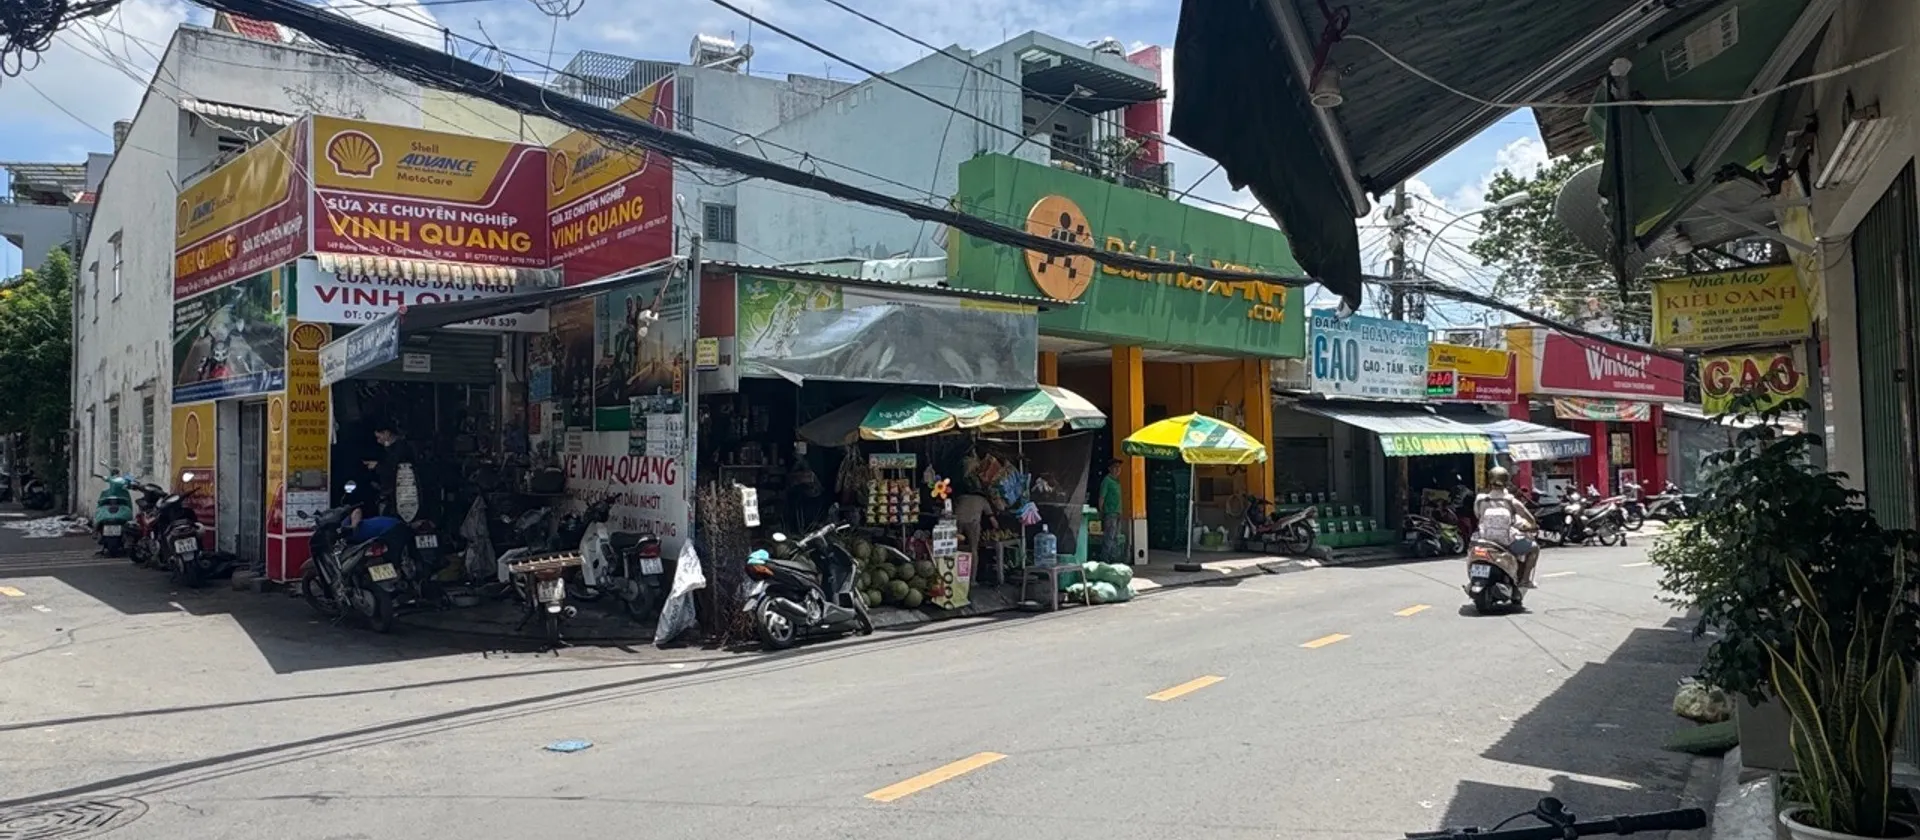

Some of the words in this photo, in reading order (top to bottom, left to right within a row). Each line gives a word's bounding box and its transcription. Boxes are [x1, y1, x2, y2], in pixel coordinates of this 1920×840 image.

[411, 141, 439, 153] Shell
[398, 153, 478, 172] ADVANCE
[397, 172, 453, 186] MotoCare
[327, 195, 361, 212] SỬA
[367, 201, 387, 214] XE
[391, 203, 456, 221] CHUYÊN
[461, 211, 518, 229] NGHIỆP
[552, 220, 583, 250] VINH
[587, 195, 644, 237] QUANG
[328, 214, 411, 242] VINH
[420, 222, 532, 253] QUANG
[197, 233, 237, 270] QUANG
[1207, 258, 1287, 307] XANH
[1689, 275, 1724, 290] Nhà
[1730, 271, 1771, 287] May
[314, 286, 405, 307] VINH
[1725, 286, 1797, 306] OANH
[499, 318, 517, 328] 539
[1314, 335, 1360, 391] GẠO
[1585, 344, 1652, 381] WinMart+
[296, 383, 321, 396] VINH
[290, 400, 326, 414] QUANG
[563, 455, 577, 478] XE
[581, 456, 615, 481] VINH
[617, 456, 676, 485] QUANG
